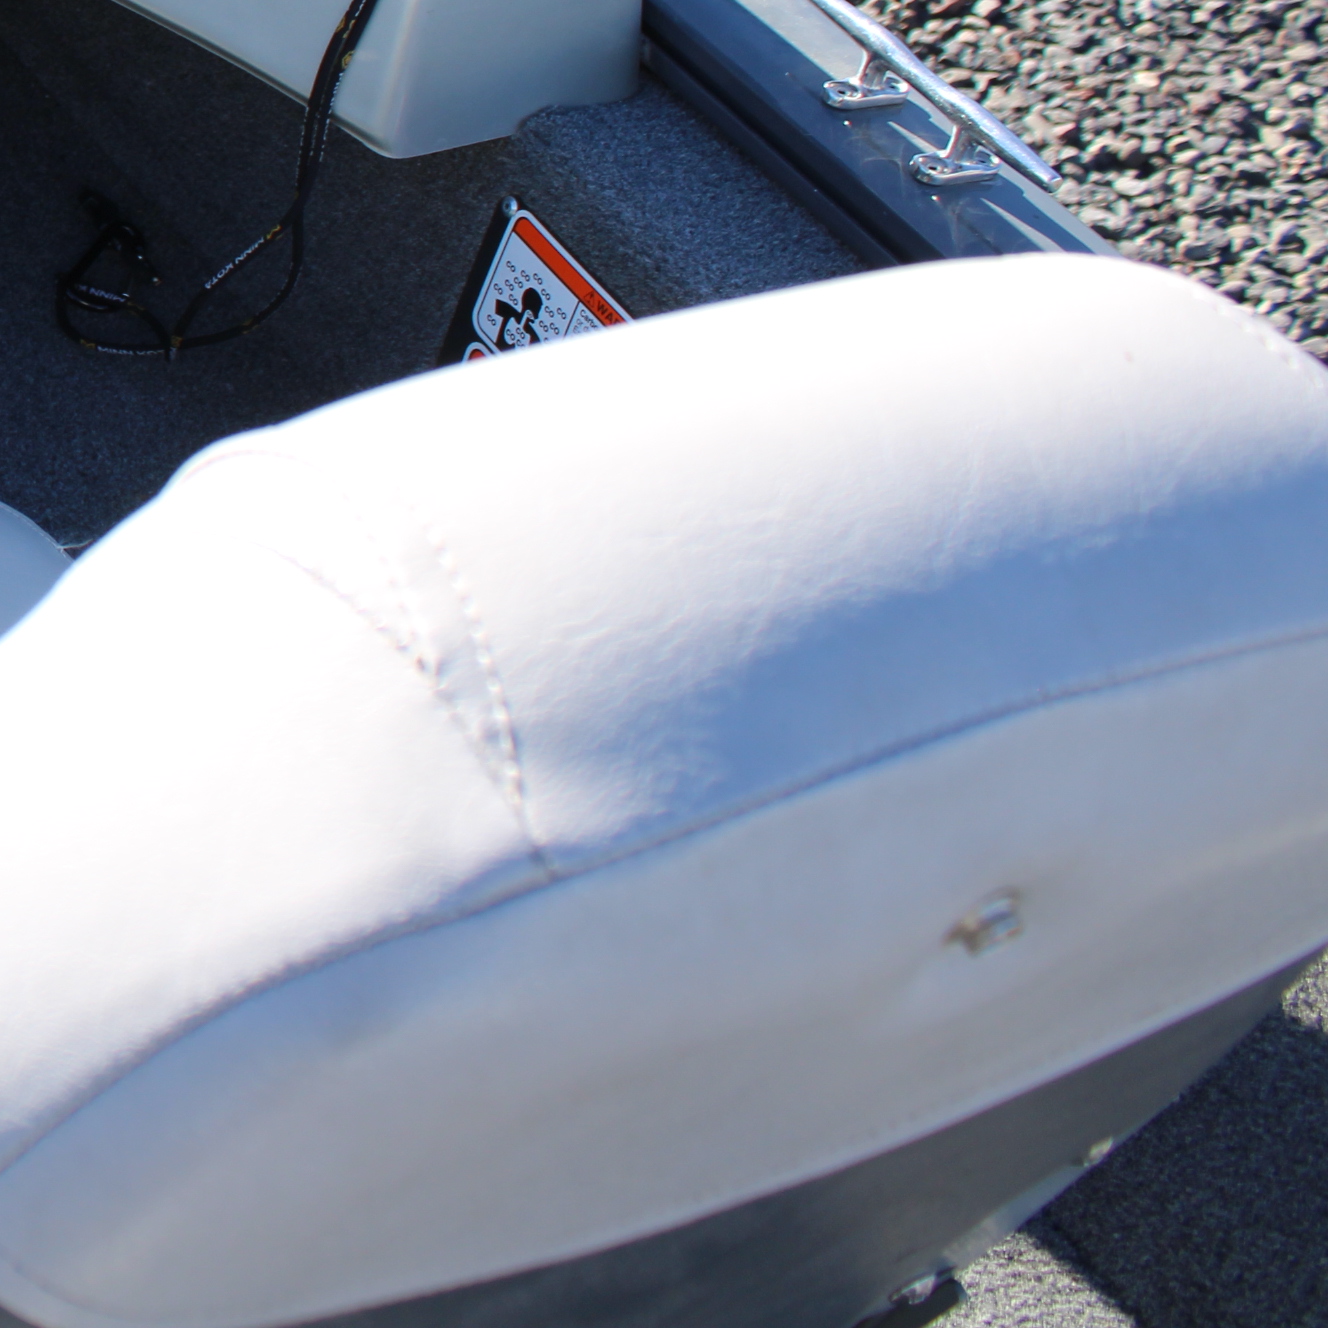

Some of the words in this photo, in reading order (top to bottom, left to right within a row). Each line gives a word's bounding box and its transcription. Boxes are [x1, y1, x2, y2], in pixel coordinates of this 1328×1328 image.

[506, 261, 516, 272] CO
[521, 270, 530, 281] CO
[533, 273, 542, 285] CO
[505, 279, 514, 291] CO
[514, 277, 523, 288] CO
[494, 283, 503, 295] CO
[541, 289, 550, 300] CO
[509, 294, 518, 305] CO
[545, 306, 554, 318] CO
[557, 308, 566, 319] CO
[487, 315, 496, 326] CO
[539, 321, 548, 332] CO
[550, 323, 559, 334] CO
[506, 329, 515, 341] CO
[516, 328, 525, 339] CO
